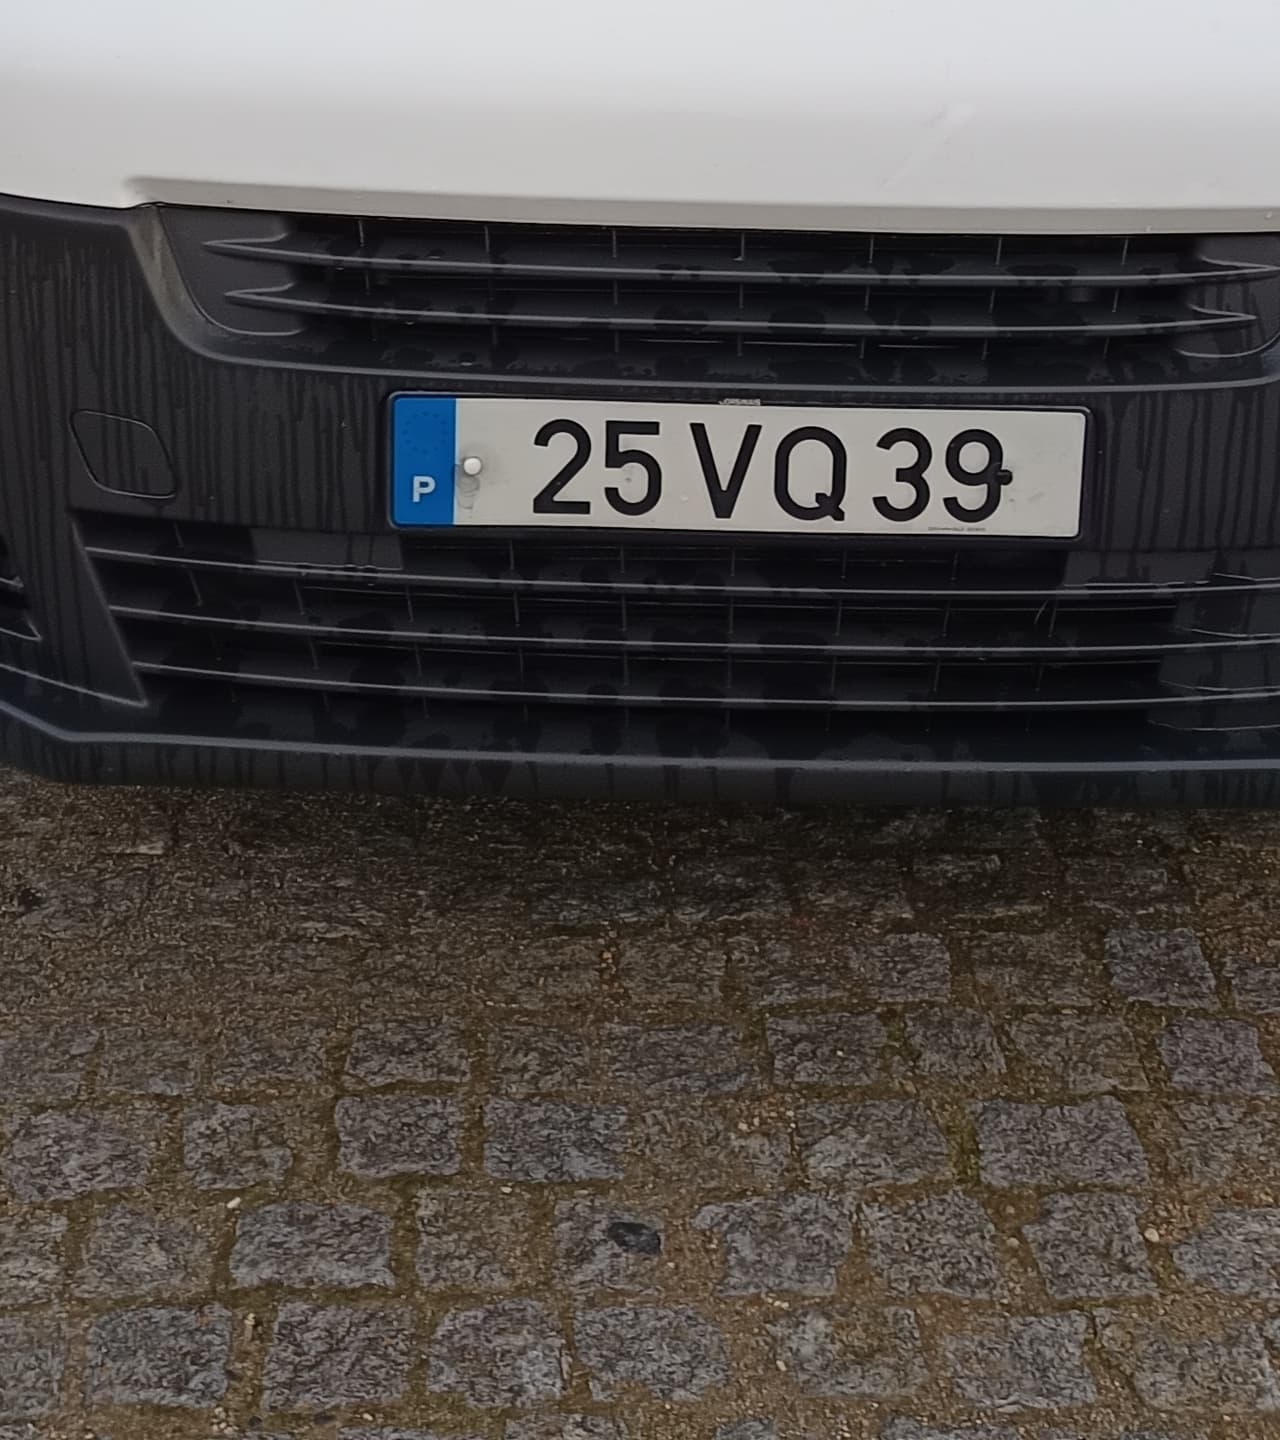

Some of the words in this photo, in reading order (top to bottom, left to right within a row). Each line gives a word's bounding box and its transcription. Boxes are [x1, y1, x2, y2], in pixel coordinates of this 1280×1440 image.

[412, 475, 436, 503] P
[531, 418, 662, 516] 25
[689, 422, 847, 522] VQ
[871, 427, 1010, 523] 39
